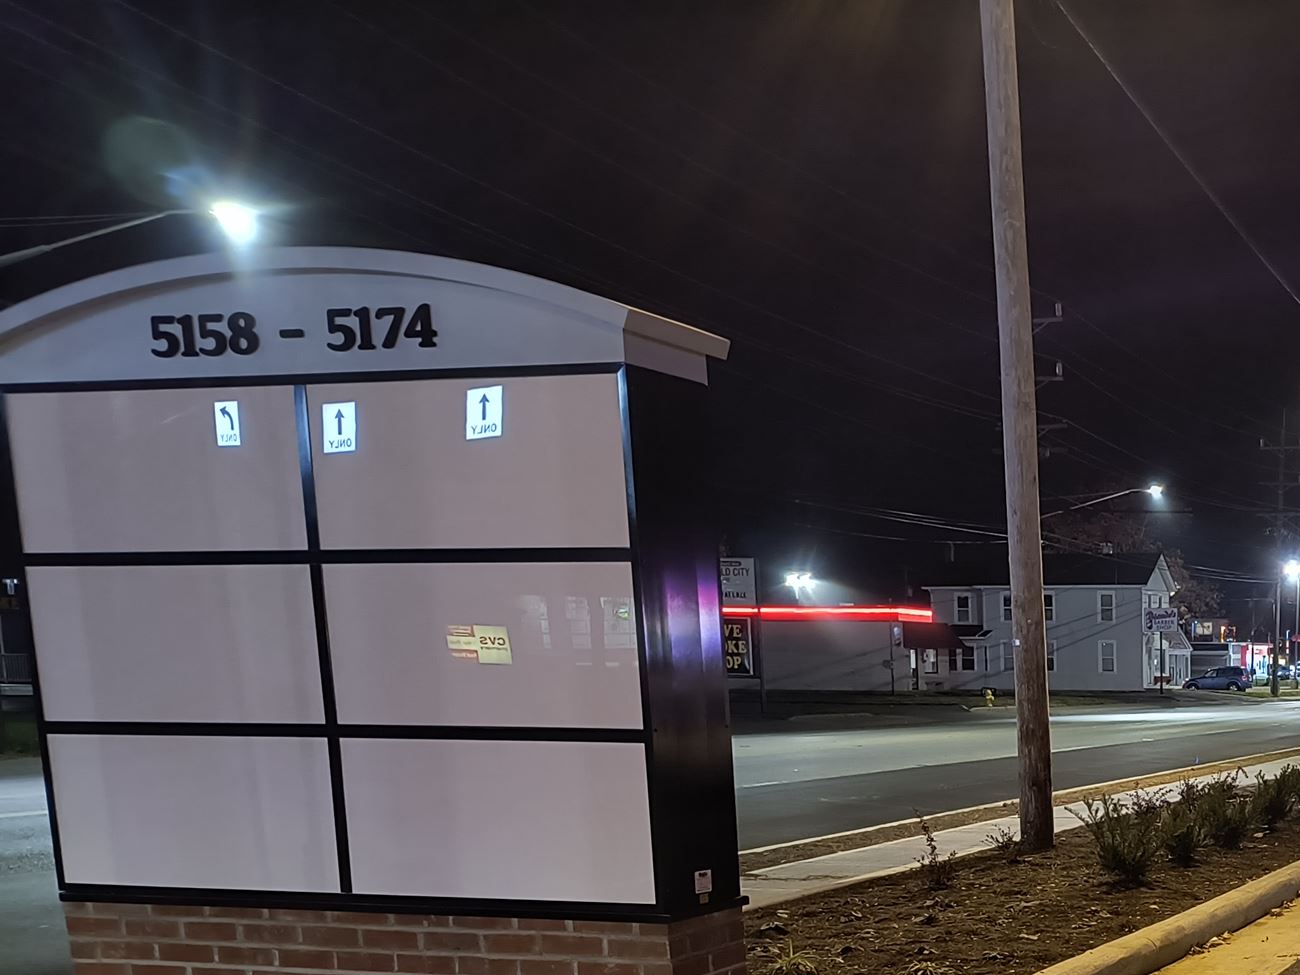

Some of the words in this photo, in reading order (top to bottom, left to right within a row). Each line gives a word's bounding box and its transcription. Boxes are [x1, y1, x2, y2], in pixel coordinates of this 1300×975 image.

[150, 312, 260, 358] 5158
[279, 328, 305, 339] -
[326, 303, 438, 352] 5174
[732, 567, 750, 577] CITY
[723, 624, 742, 638] VE
[726, 656, 742, 669] OP
